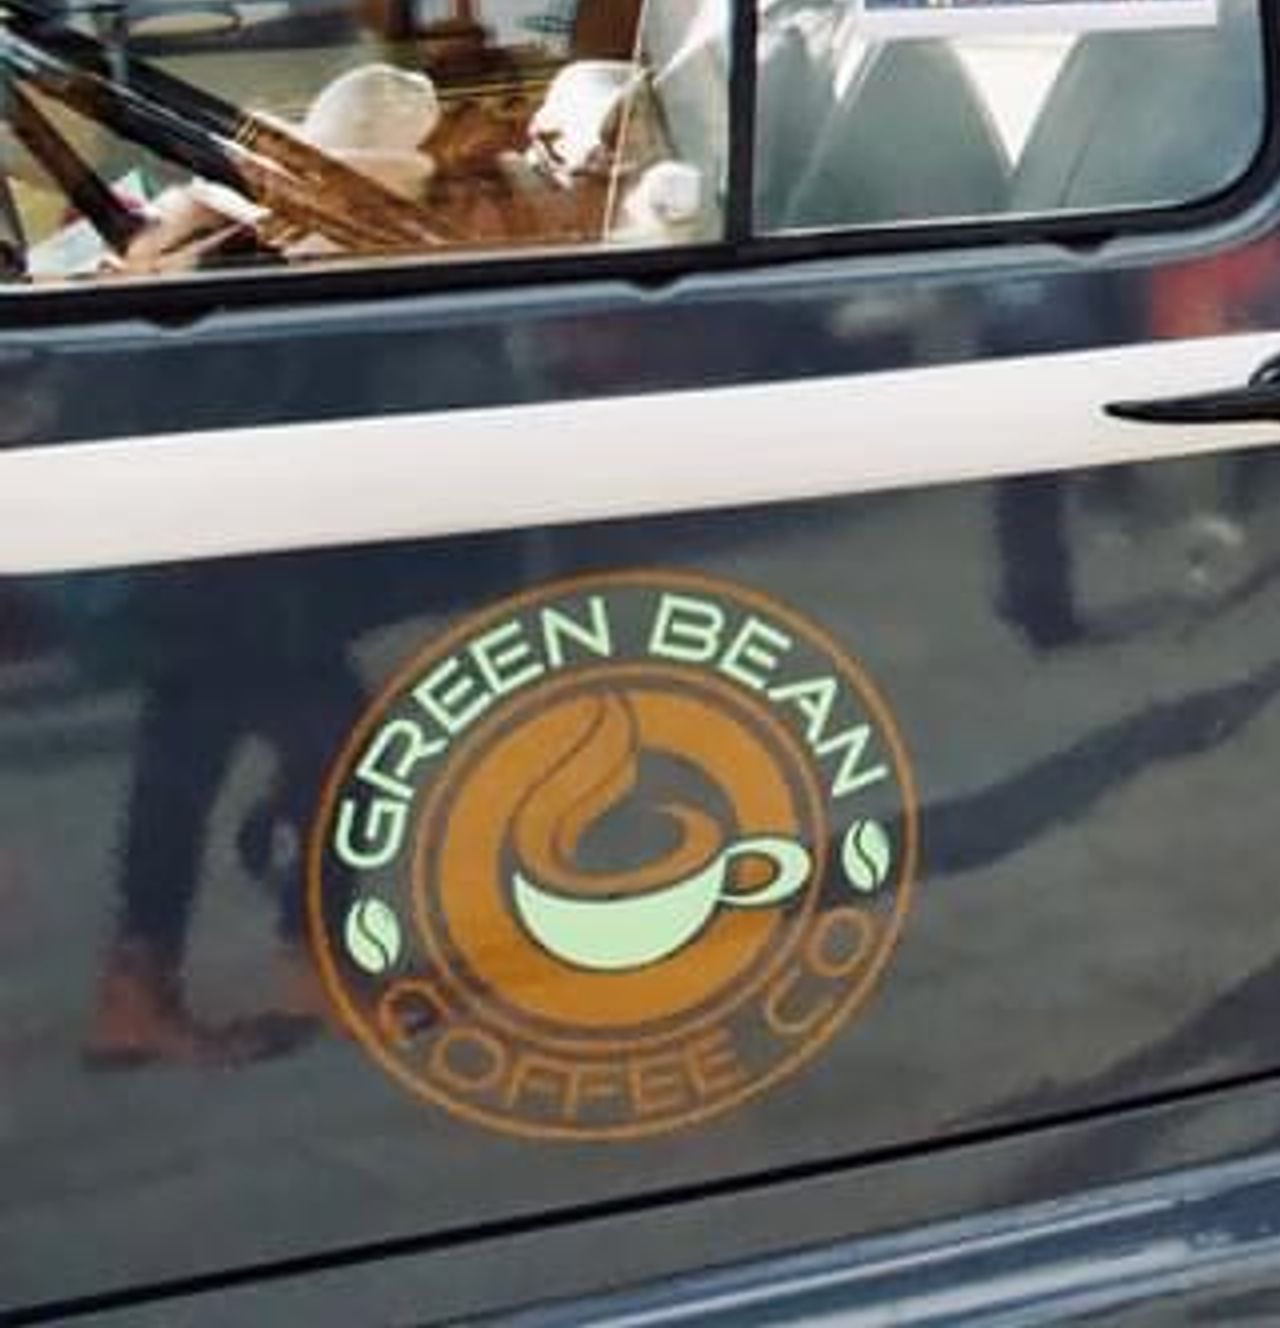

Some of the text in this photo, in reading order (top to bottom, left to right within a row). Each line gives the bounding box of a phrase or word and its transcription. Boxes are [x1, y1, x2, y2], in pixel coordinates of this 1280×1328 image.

[334, 593, 889, 869] GREEN BEAN
[378, 906, 874, 1121] COFFEE CO
